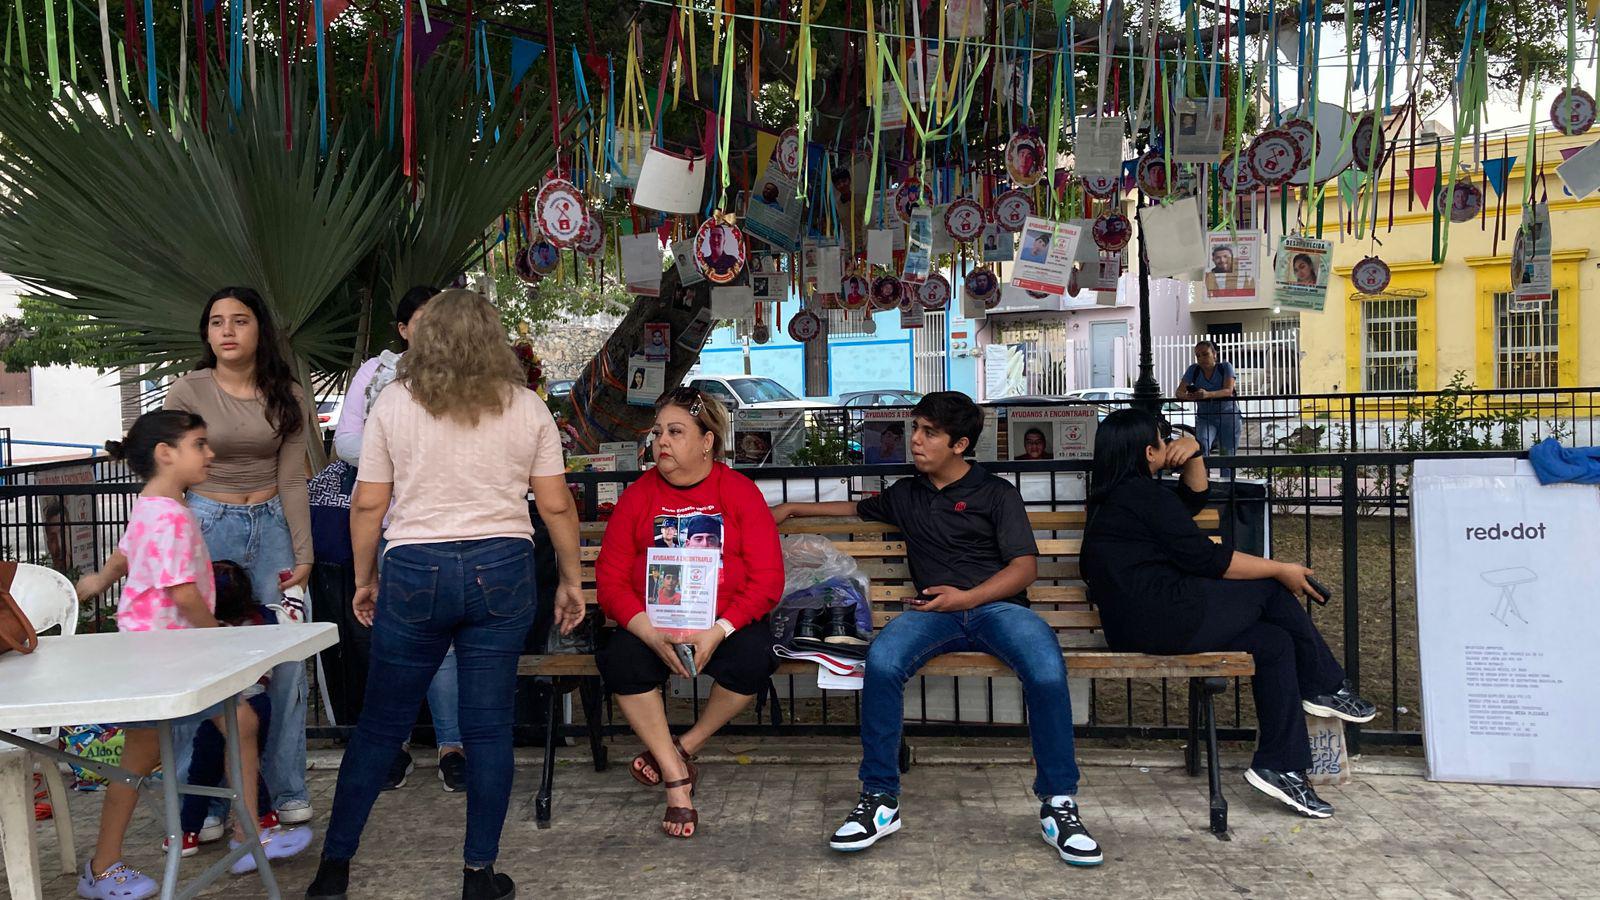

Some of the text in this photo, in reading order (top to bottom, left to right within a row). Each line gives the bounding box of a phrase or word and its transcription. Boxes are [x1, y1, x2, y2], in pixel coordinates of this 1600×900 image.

[1011, 410, 1042, 418] AYUDANOS
[1049, 409, 1095, 418] ENCONTRARLO
[86, 746, 112, 758] Aldo
[1311, 748, 1341, 763] ody
